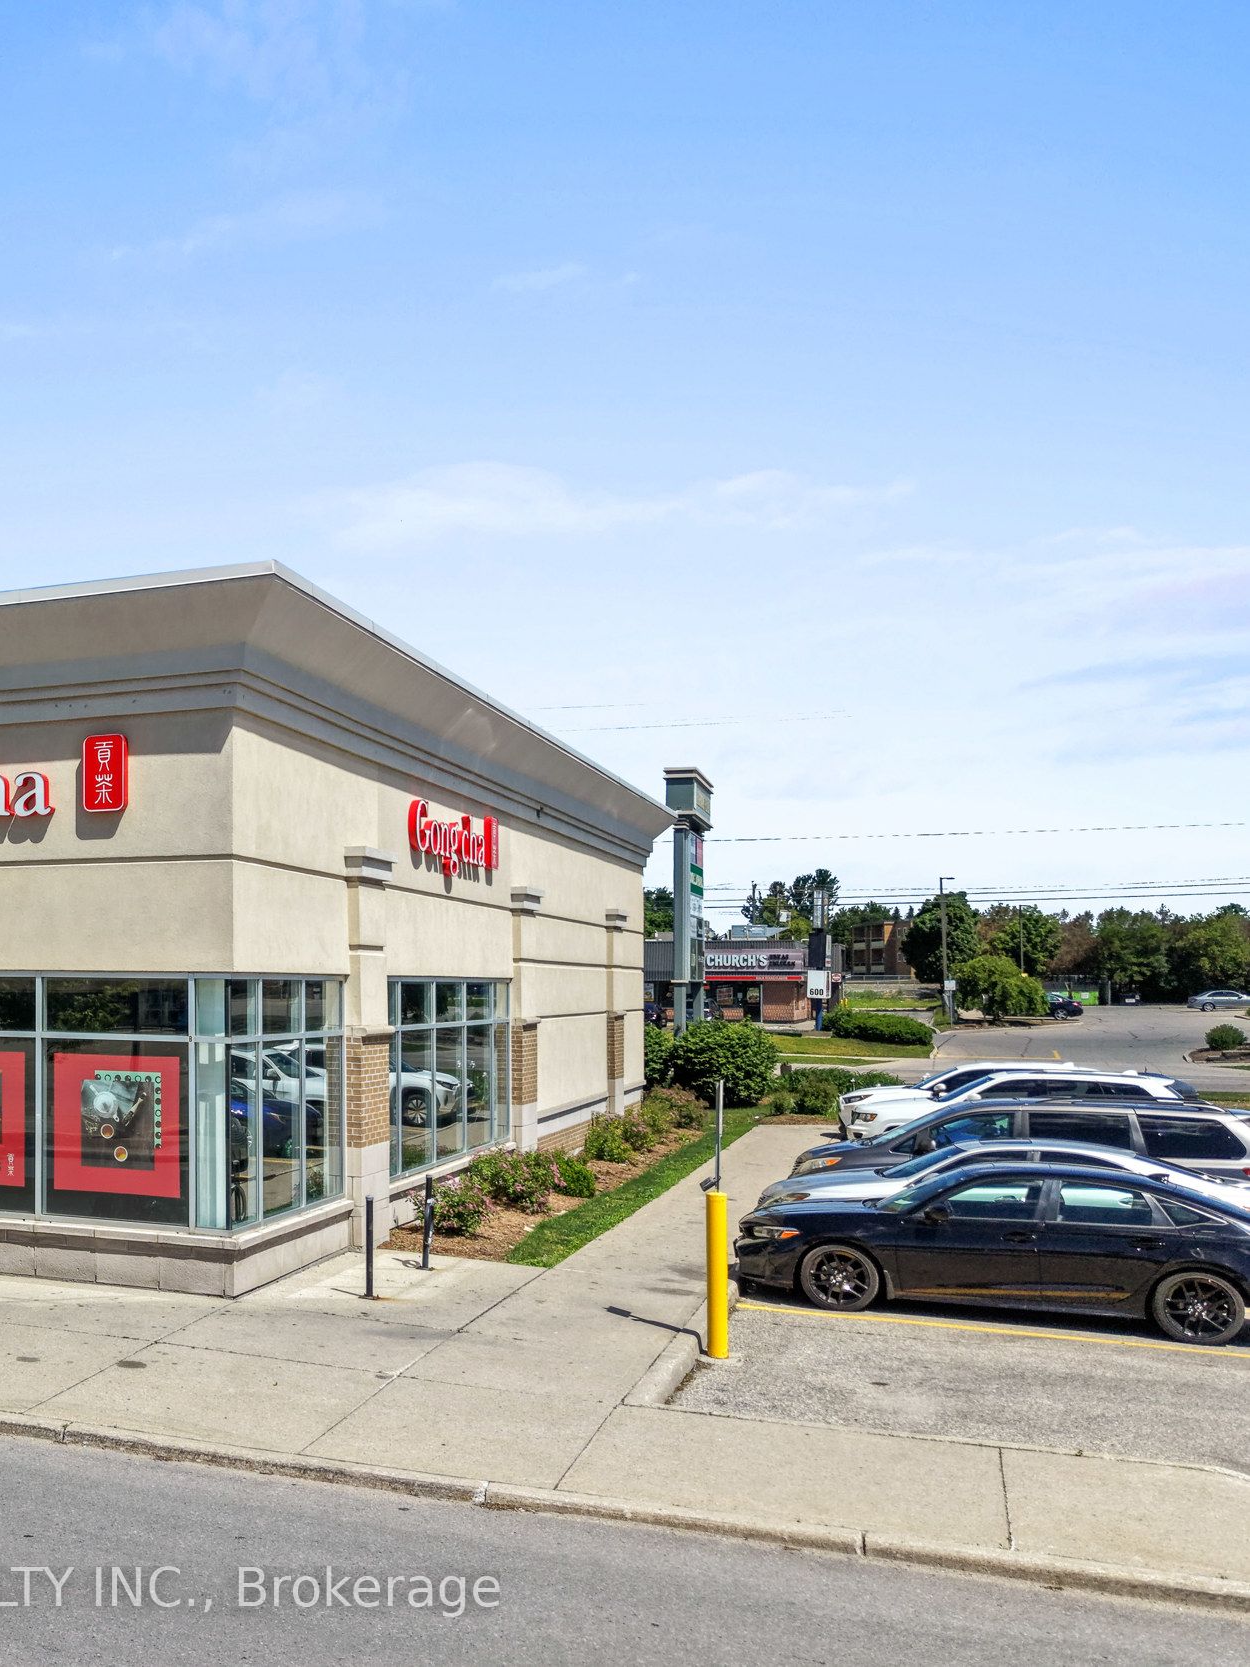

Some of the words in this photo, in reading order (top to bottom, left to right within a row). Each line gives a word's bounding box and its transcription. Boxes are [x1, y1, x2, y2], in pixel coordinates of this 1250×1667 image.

[410, 799, 460, 877] Gong
[461, 815, 486, 868] cha
[706, 953, 768, 967] CHURCH'S
[809, 988, 824, 996] 600
